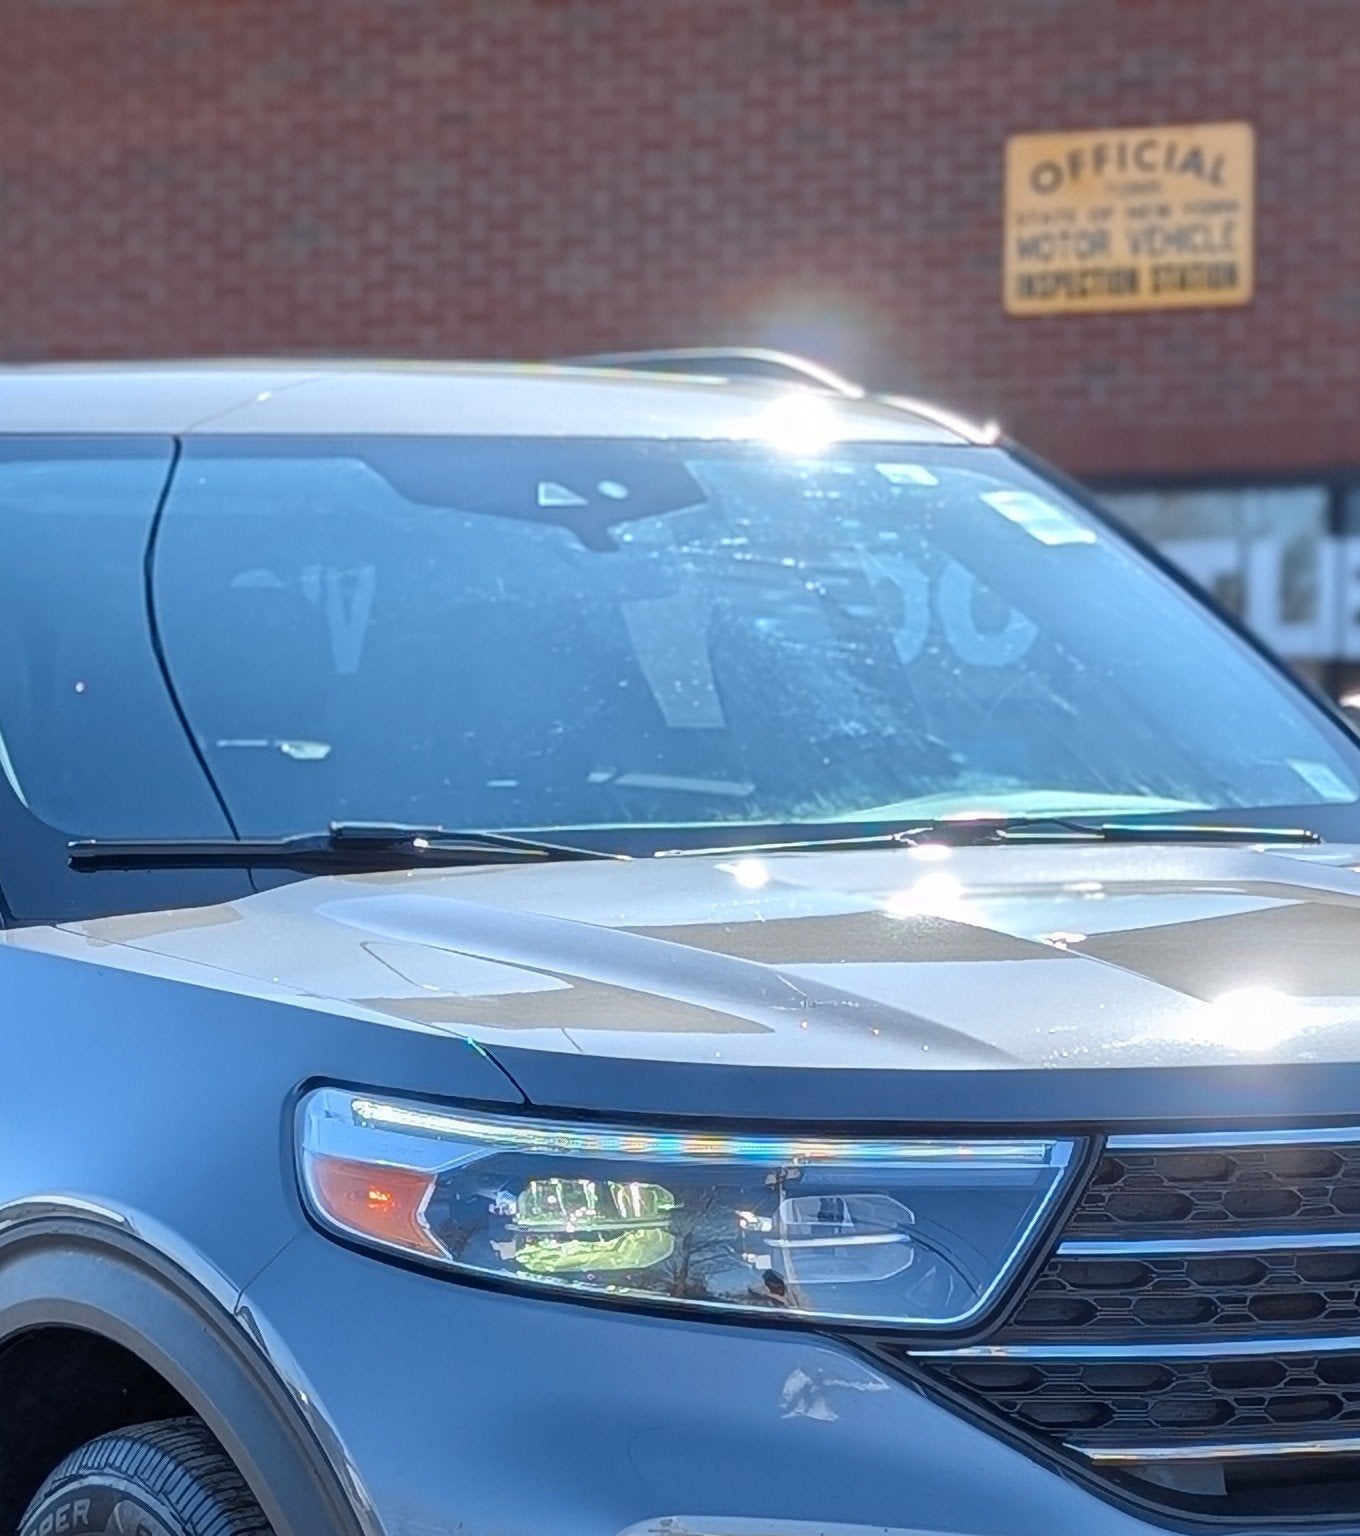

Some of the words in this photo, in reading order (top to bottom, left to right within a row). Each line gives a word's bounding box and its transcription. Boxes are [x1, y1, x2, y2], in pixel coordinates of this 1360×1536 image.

[1029, 138, 1226, 196] OFFICIAL
[1016, 228, 1111, 263] MOTOR
[1128, 220, 1237, 257] VEHICLE
